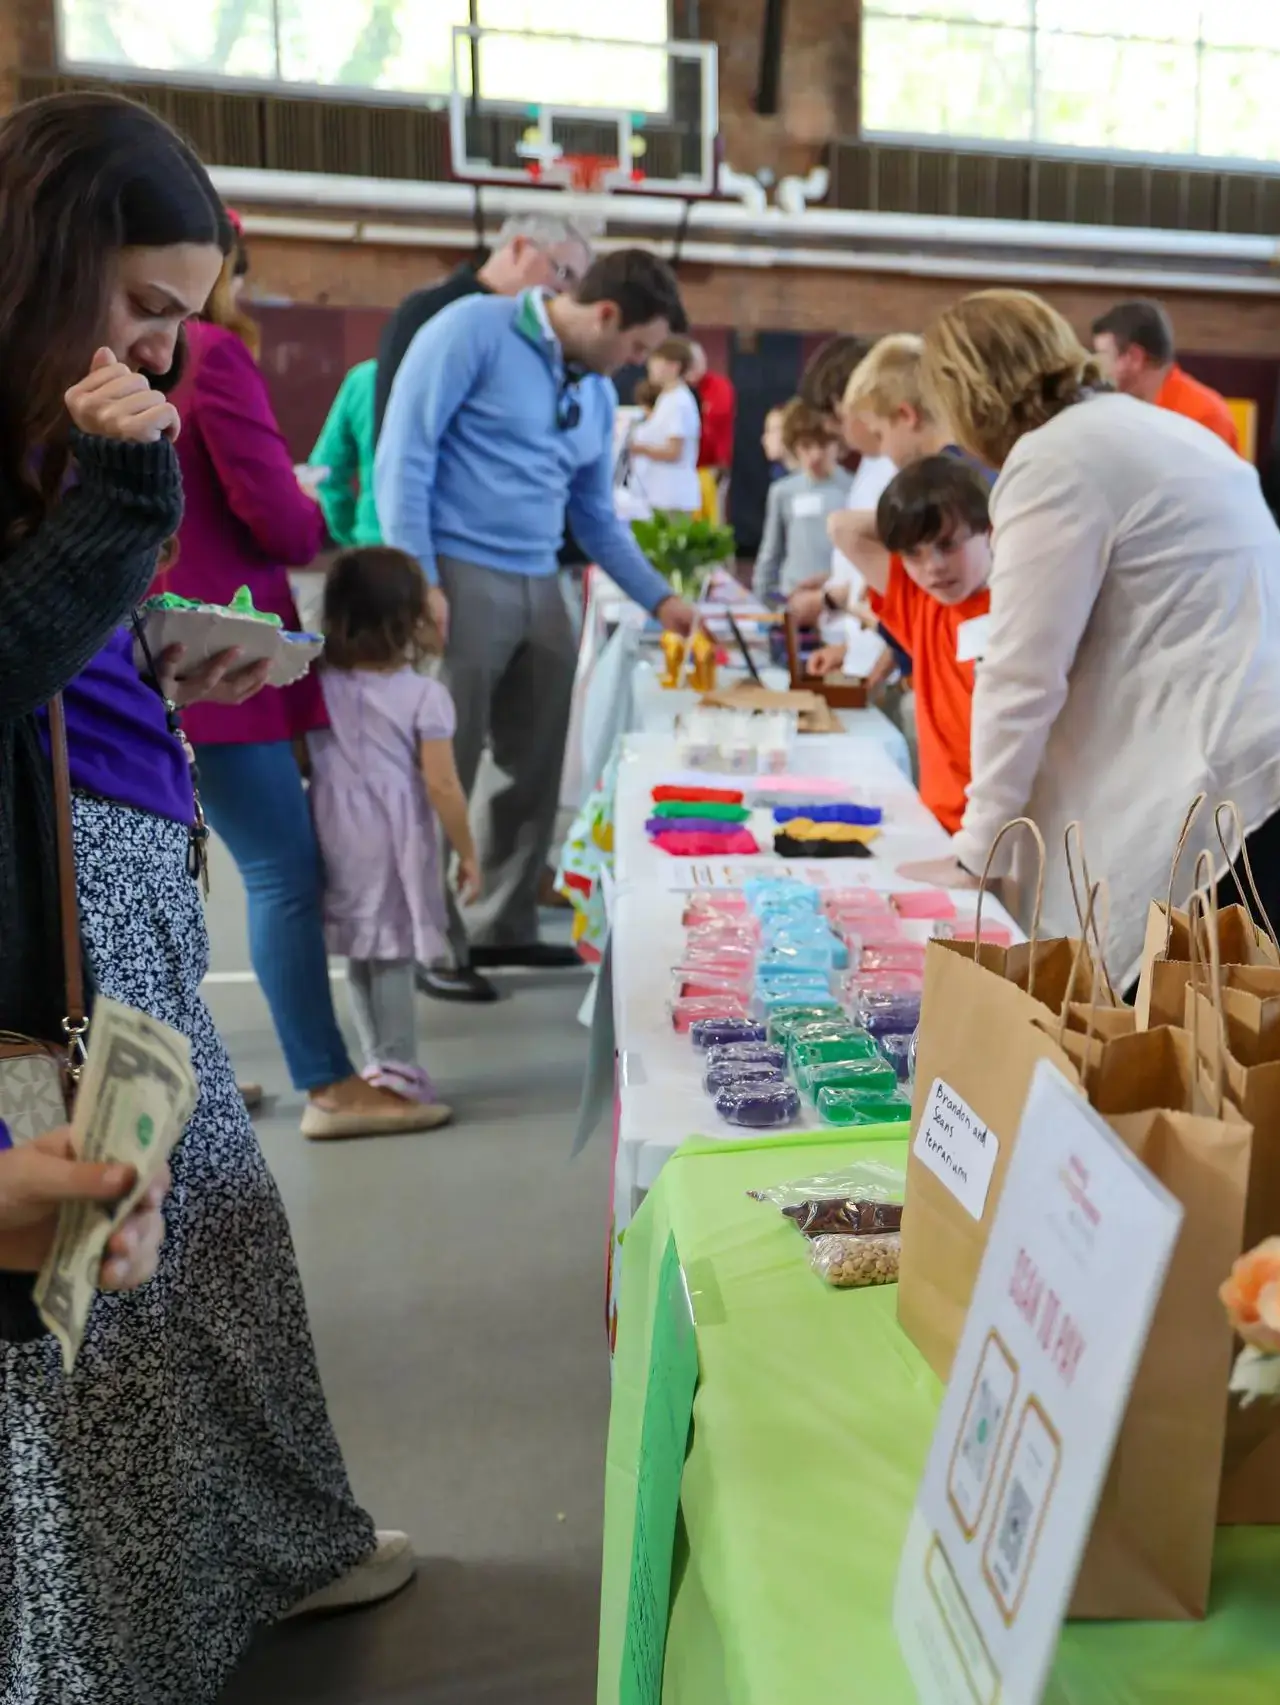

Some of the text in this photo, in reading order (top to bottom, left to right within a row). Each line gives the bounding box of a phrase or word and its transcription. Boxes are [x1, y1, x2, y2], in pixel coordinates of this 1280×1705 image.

[932, 1105, 955, 1138] Seans
[935, 1084, 988, 1148] Brandon and
